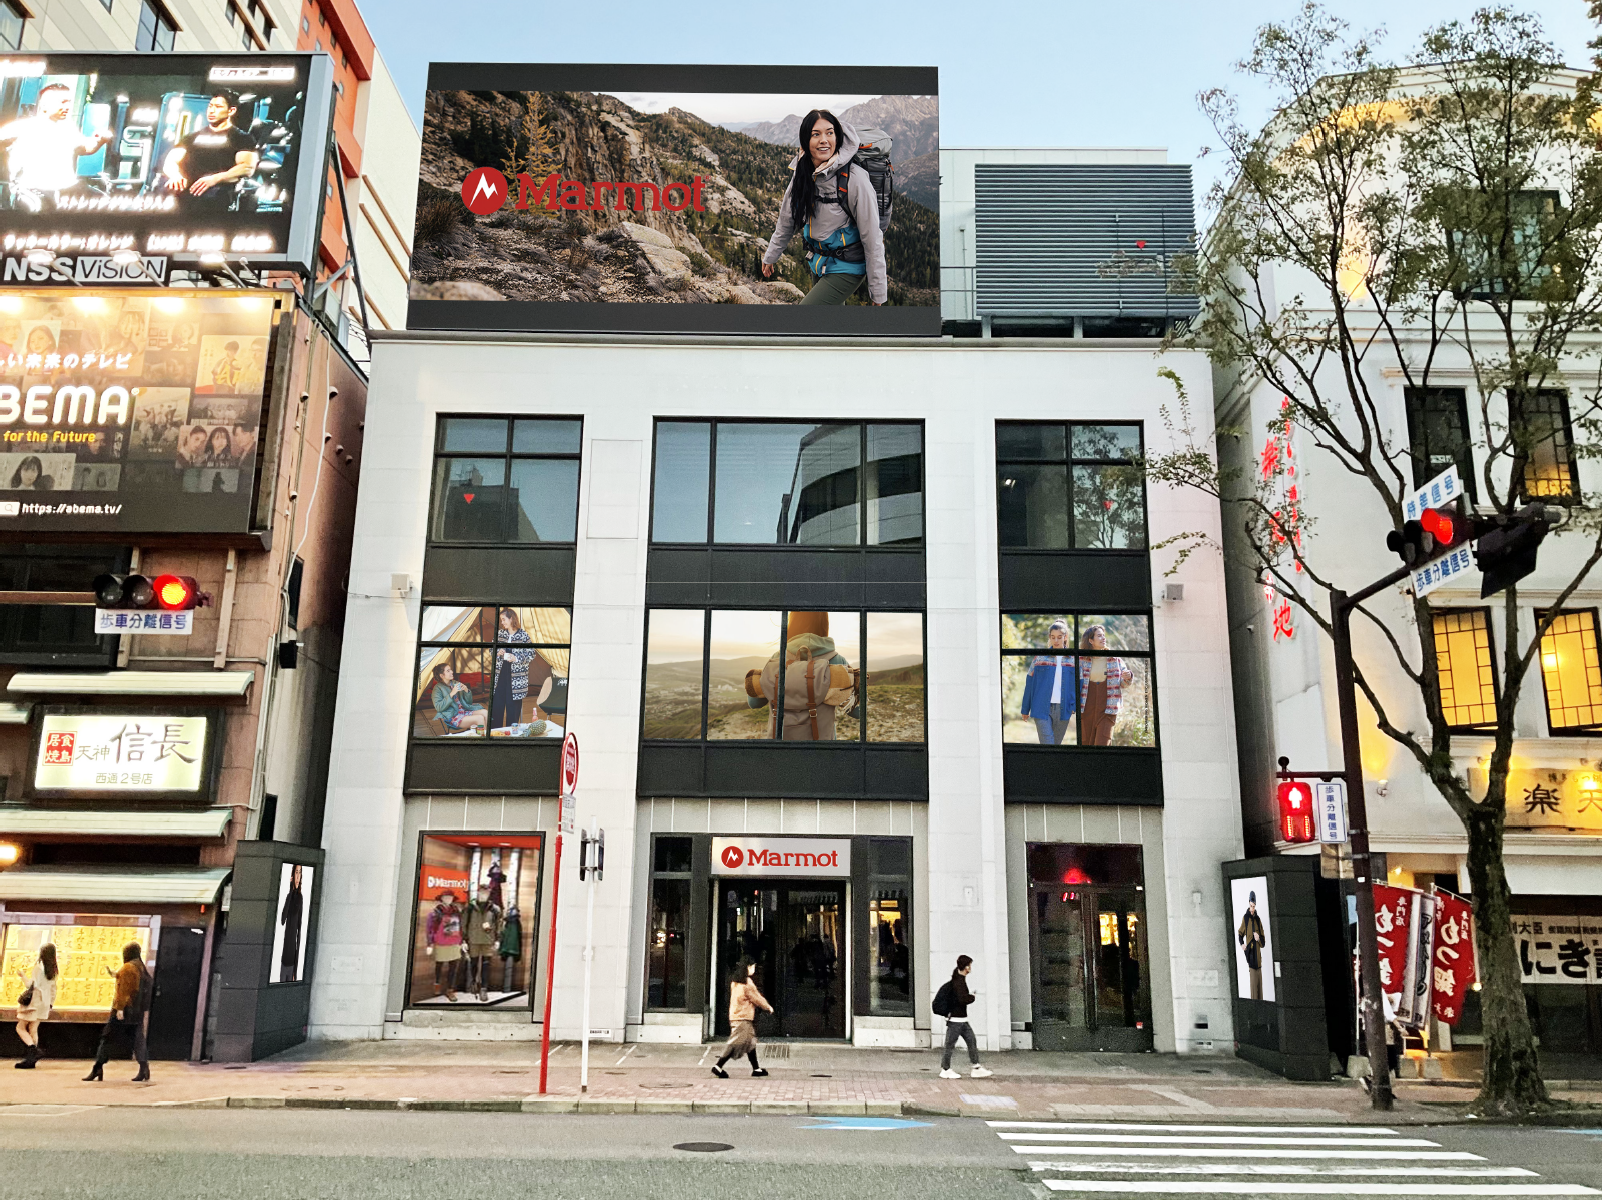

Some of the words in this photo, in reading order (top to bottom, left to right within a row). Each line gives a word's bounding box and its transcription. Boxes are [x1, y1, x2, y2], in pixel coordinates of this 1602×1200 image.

[515, 173, 706, 212] Marmot
[4, 257, 73, 281] NSS
[0, 353, 132, 369] い未来のテレビ
[4, 431, 24, 442] for
[27, 431, 48, 442] the
[53, 431, 96, 442] Future
[22, 503, 122, 515] https://abema.tv/
[1416, 548, 1469, 592] 歩車分離信号
[99, 613, 188, 630] 歩車分離信号
[1325, 785, 1338, 841] 歩車分離信号
[747, 848, 839, 868] Marmot
